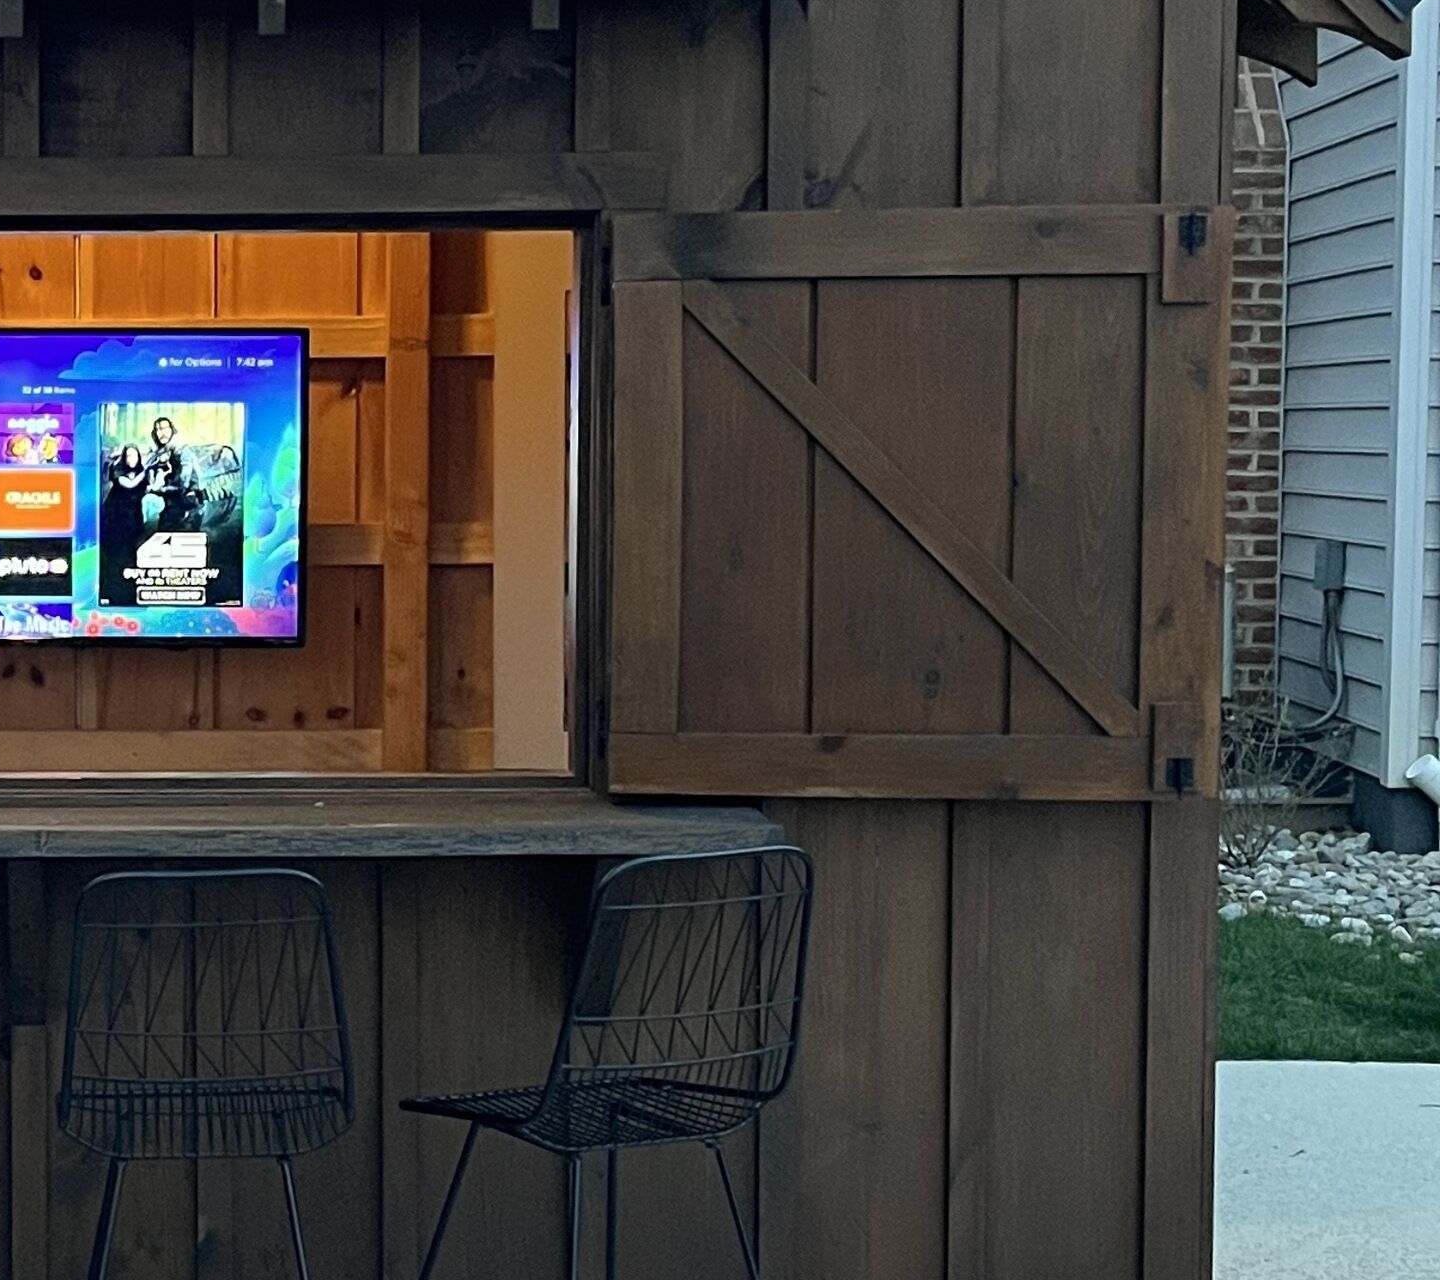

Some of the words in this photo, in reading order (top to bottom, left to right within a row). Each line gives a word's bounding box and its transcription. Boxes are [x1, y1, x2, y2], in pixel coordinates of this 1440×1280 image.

[185, 357, 222, 369] Options
[136, 532, 208, 568] 65
[24, 615, 72, 634] Music
